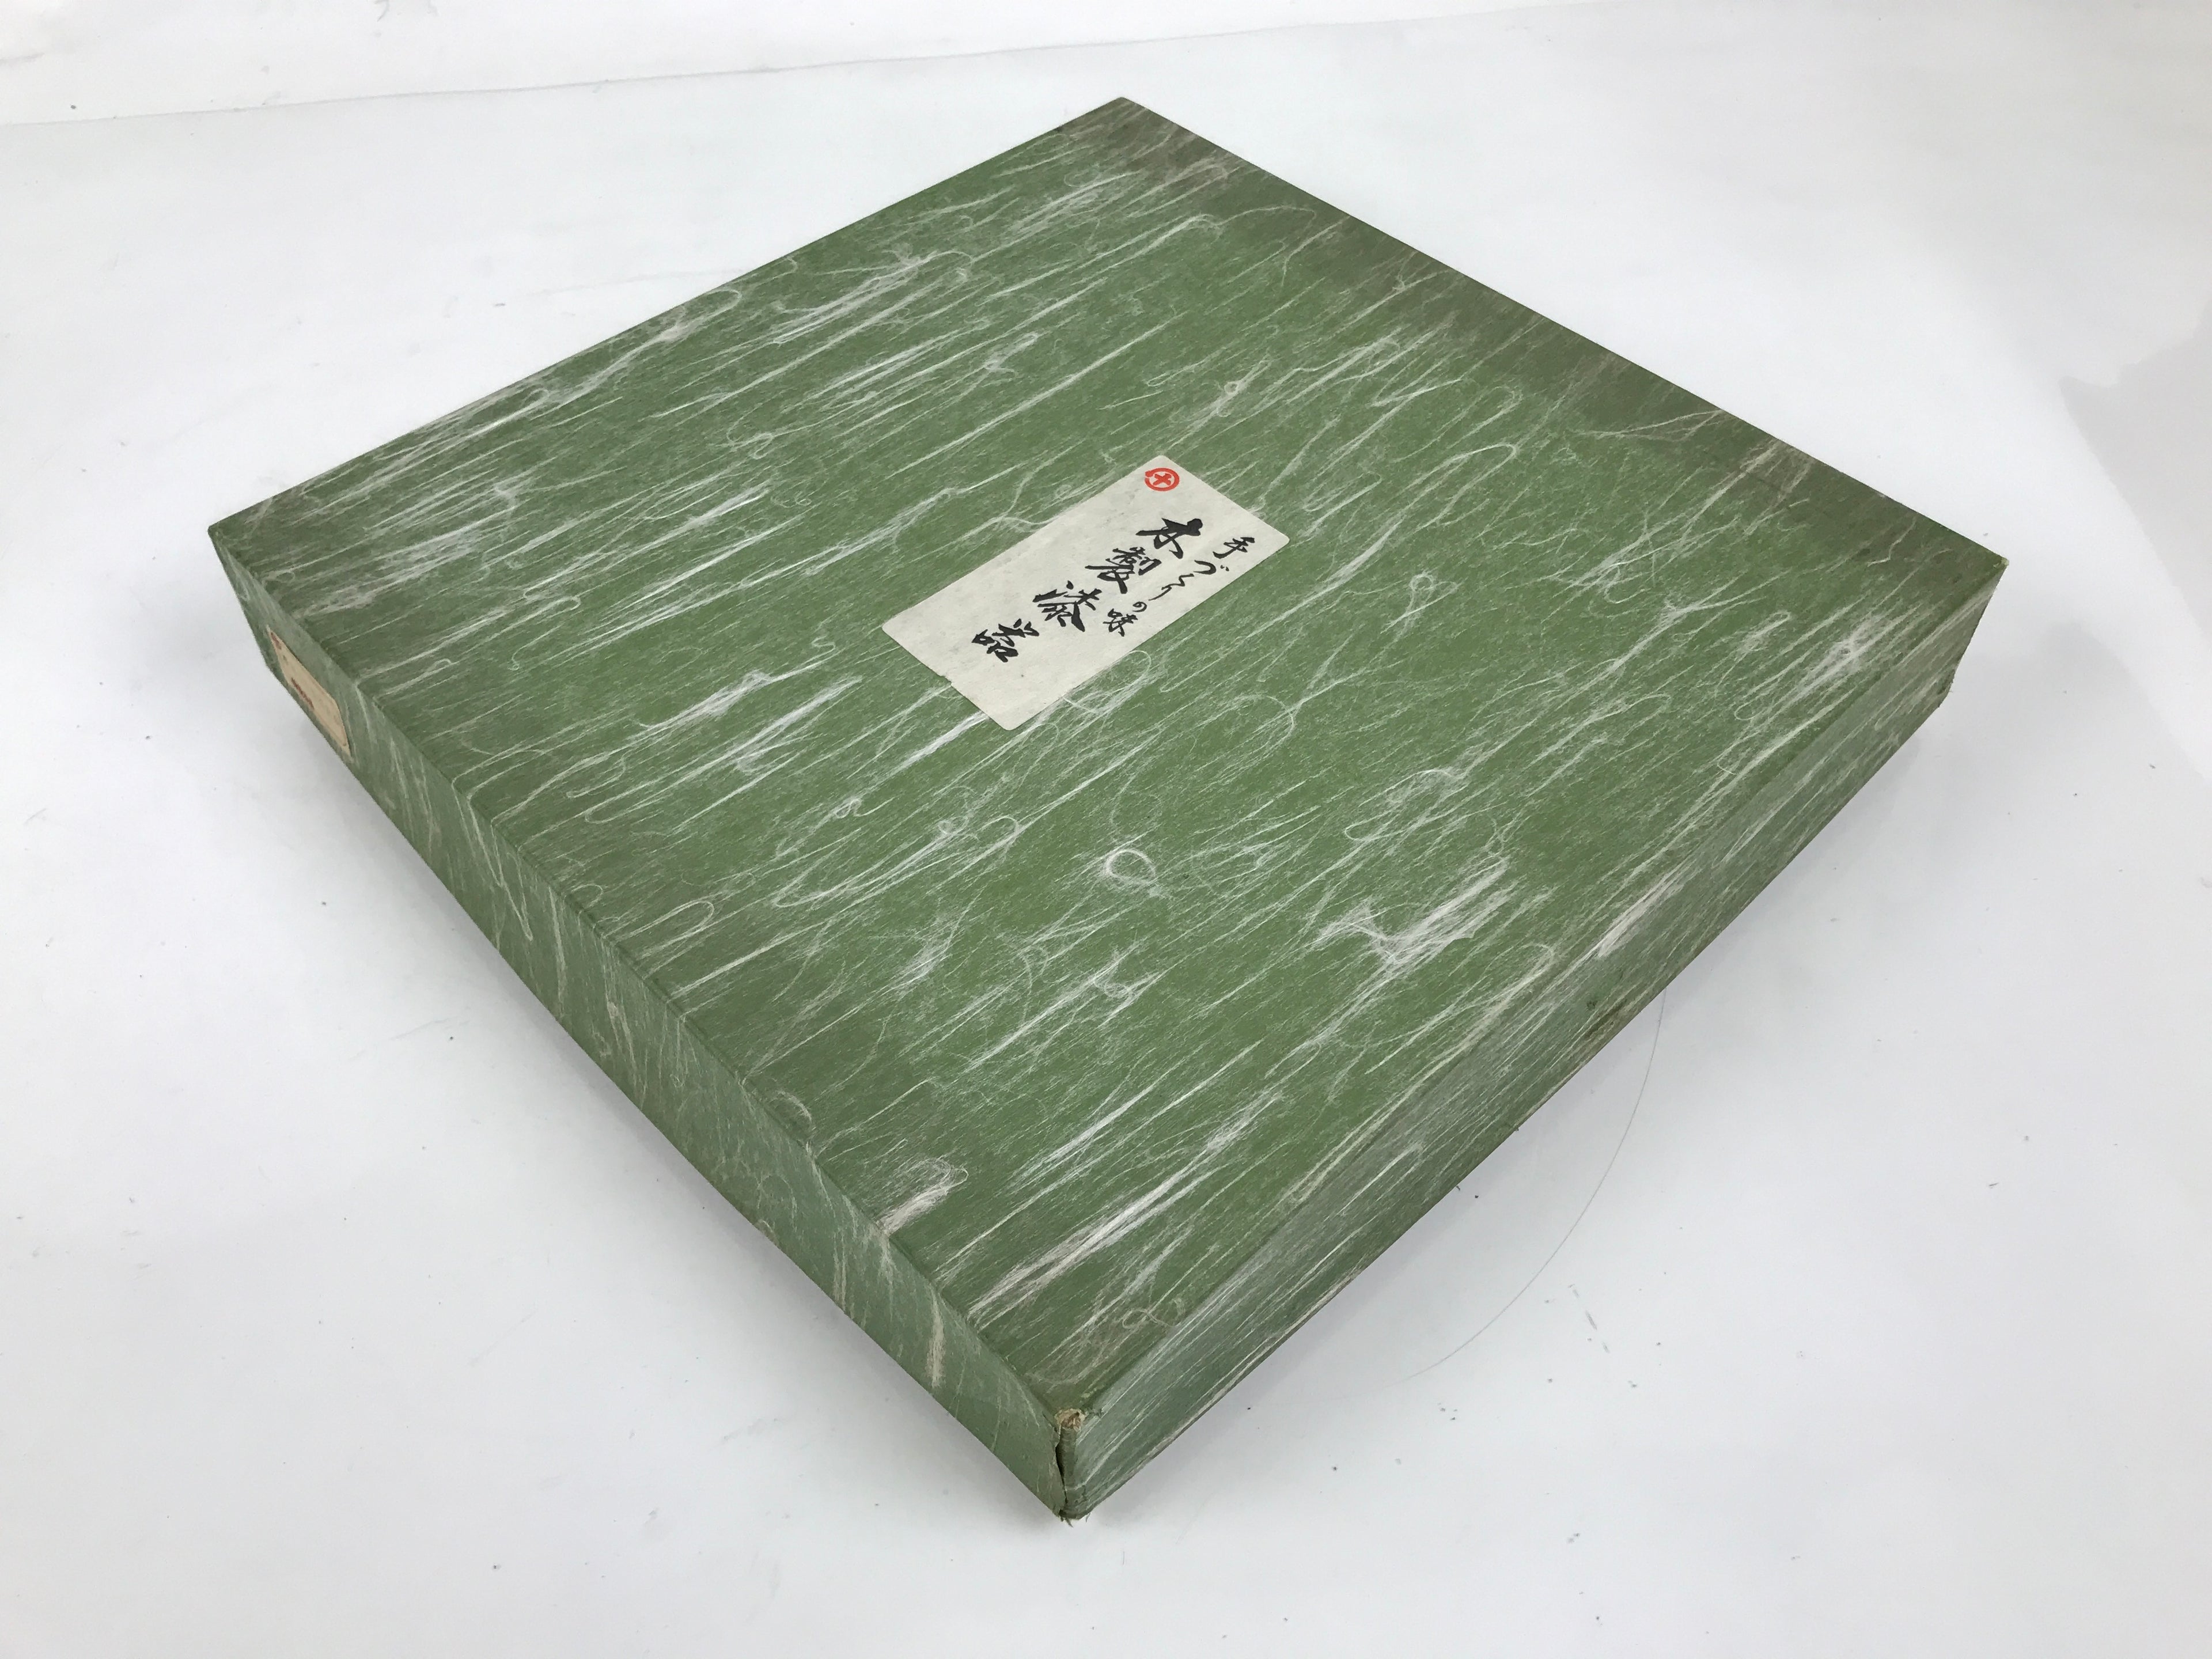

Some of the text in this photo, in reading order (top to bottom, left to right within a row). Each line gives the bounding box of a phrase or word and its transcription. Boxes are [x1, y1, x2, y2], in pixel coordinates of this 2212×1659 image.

[971, 518, 1203, 663] 木製漆器
[1103, 537, 1255, 637] 手づくりの味
